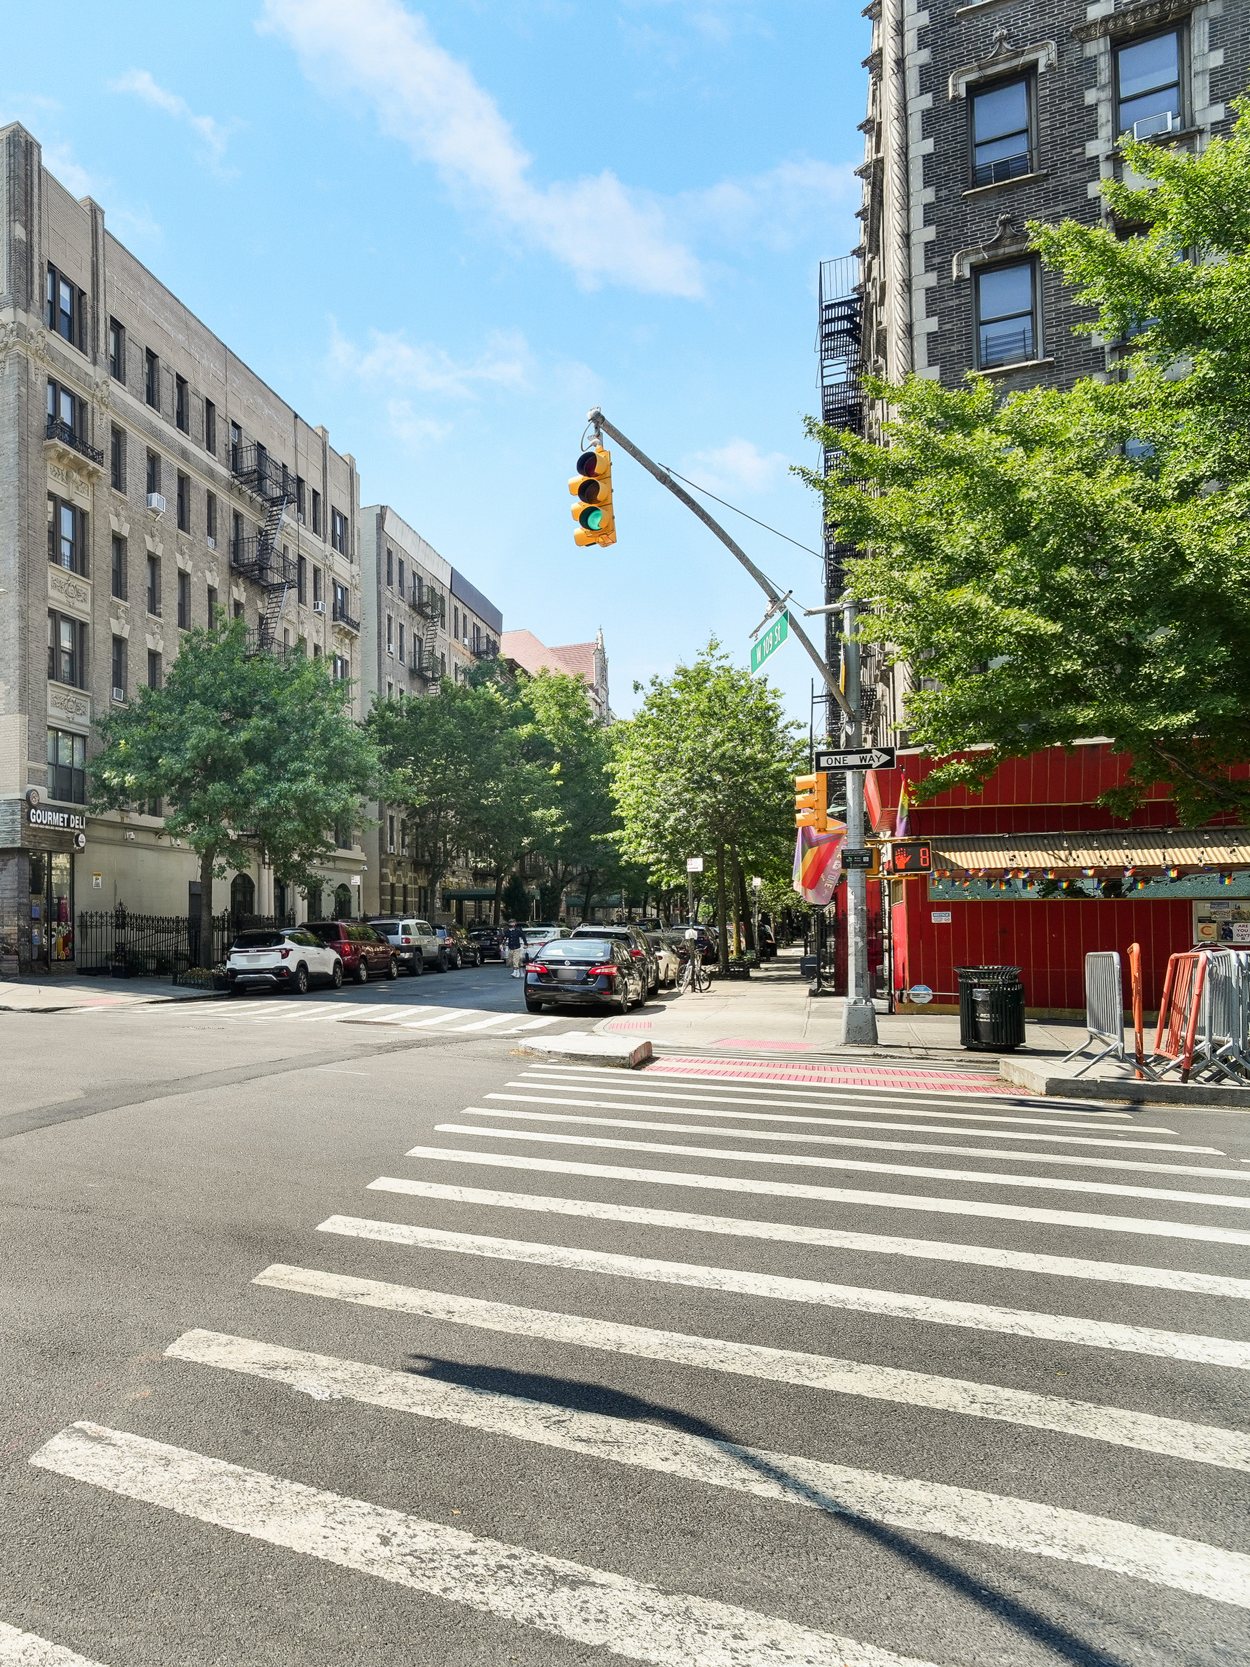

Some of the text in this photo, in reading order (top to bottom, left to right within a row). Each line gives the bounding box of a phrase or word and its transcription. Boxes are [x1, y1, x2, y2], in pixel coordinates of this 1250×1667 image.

[756, 622, 781, 664] W 109 St
[826, 754, 883, 765] ONE WAY
[30, 808, 69, 827] GOURMET
[70, 814, 86, 829] DELI
[919, 847, 930, 867] 8
